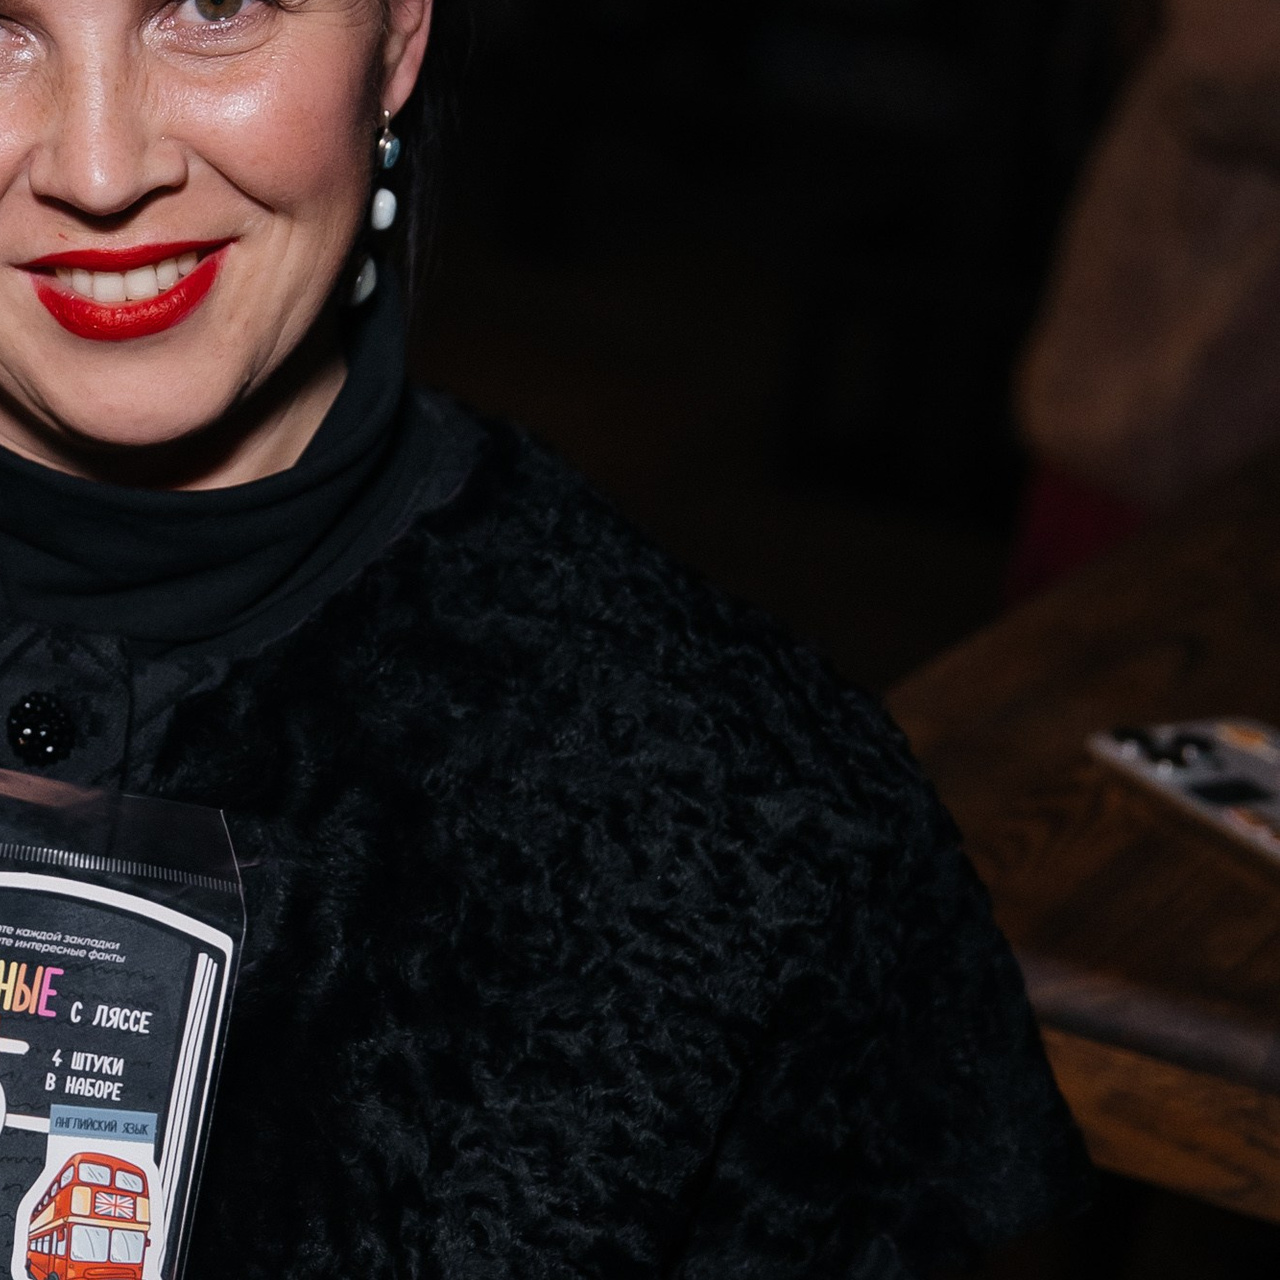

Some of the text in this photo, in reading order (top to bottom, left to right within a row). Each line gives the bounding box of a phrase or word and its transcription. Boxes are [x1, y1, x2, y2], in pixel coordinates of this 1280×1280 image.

[14, 939, 87, 957] интересные
[88, 949, 126, 963] факты
[15, 927, 62, 941] каждой
[63, 934, 120, 950] закладки
[70, 1001, 83, 1023] С
[92, 1004, 153, 1034] ЛЯССЕ
[52, 1048, 124, 1077] 4 ШТУКИ
[45, 1072, 124, 1101] В НАБОРЕ
[54, 1116, 150, 1136] АНГЛИЙСКИЙ ЯЗЫК
